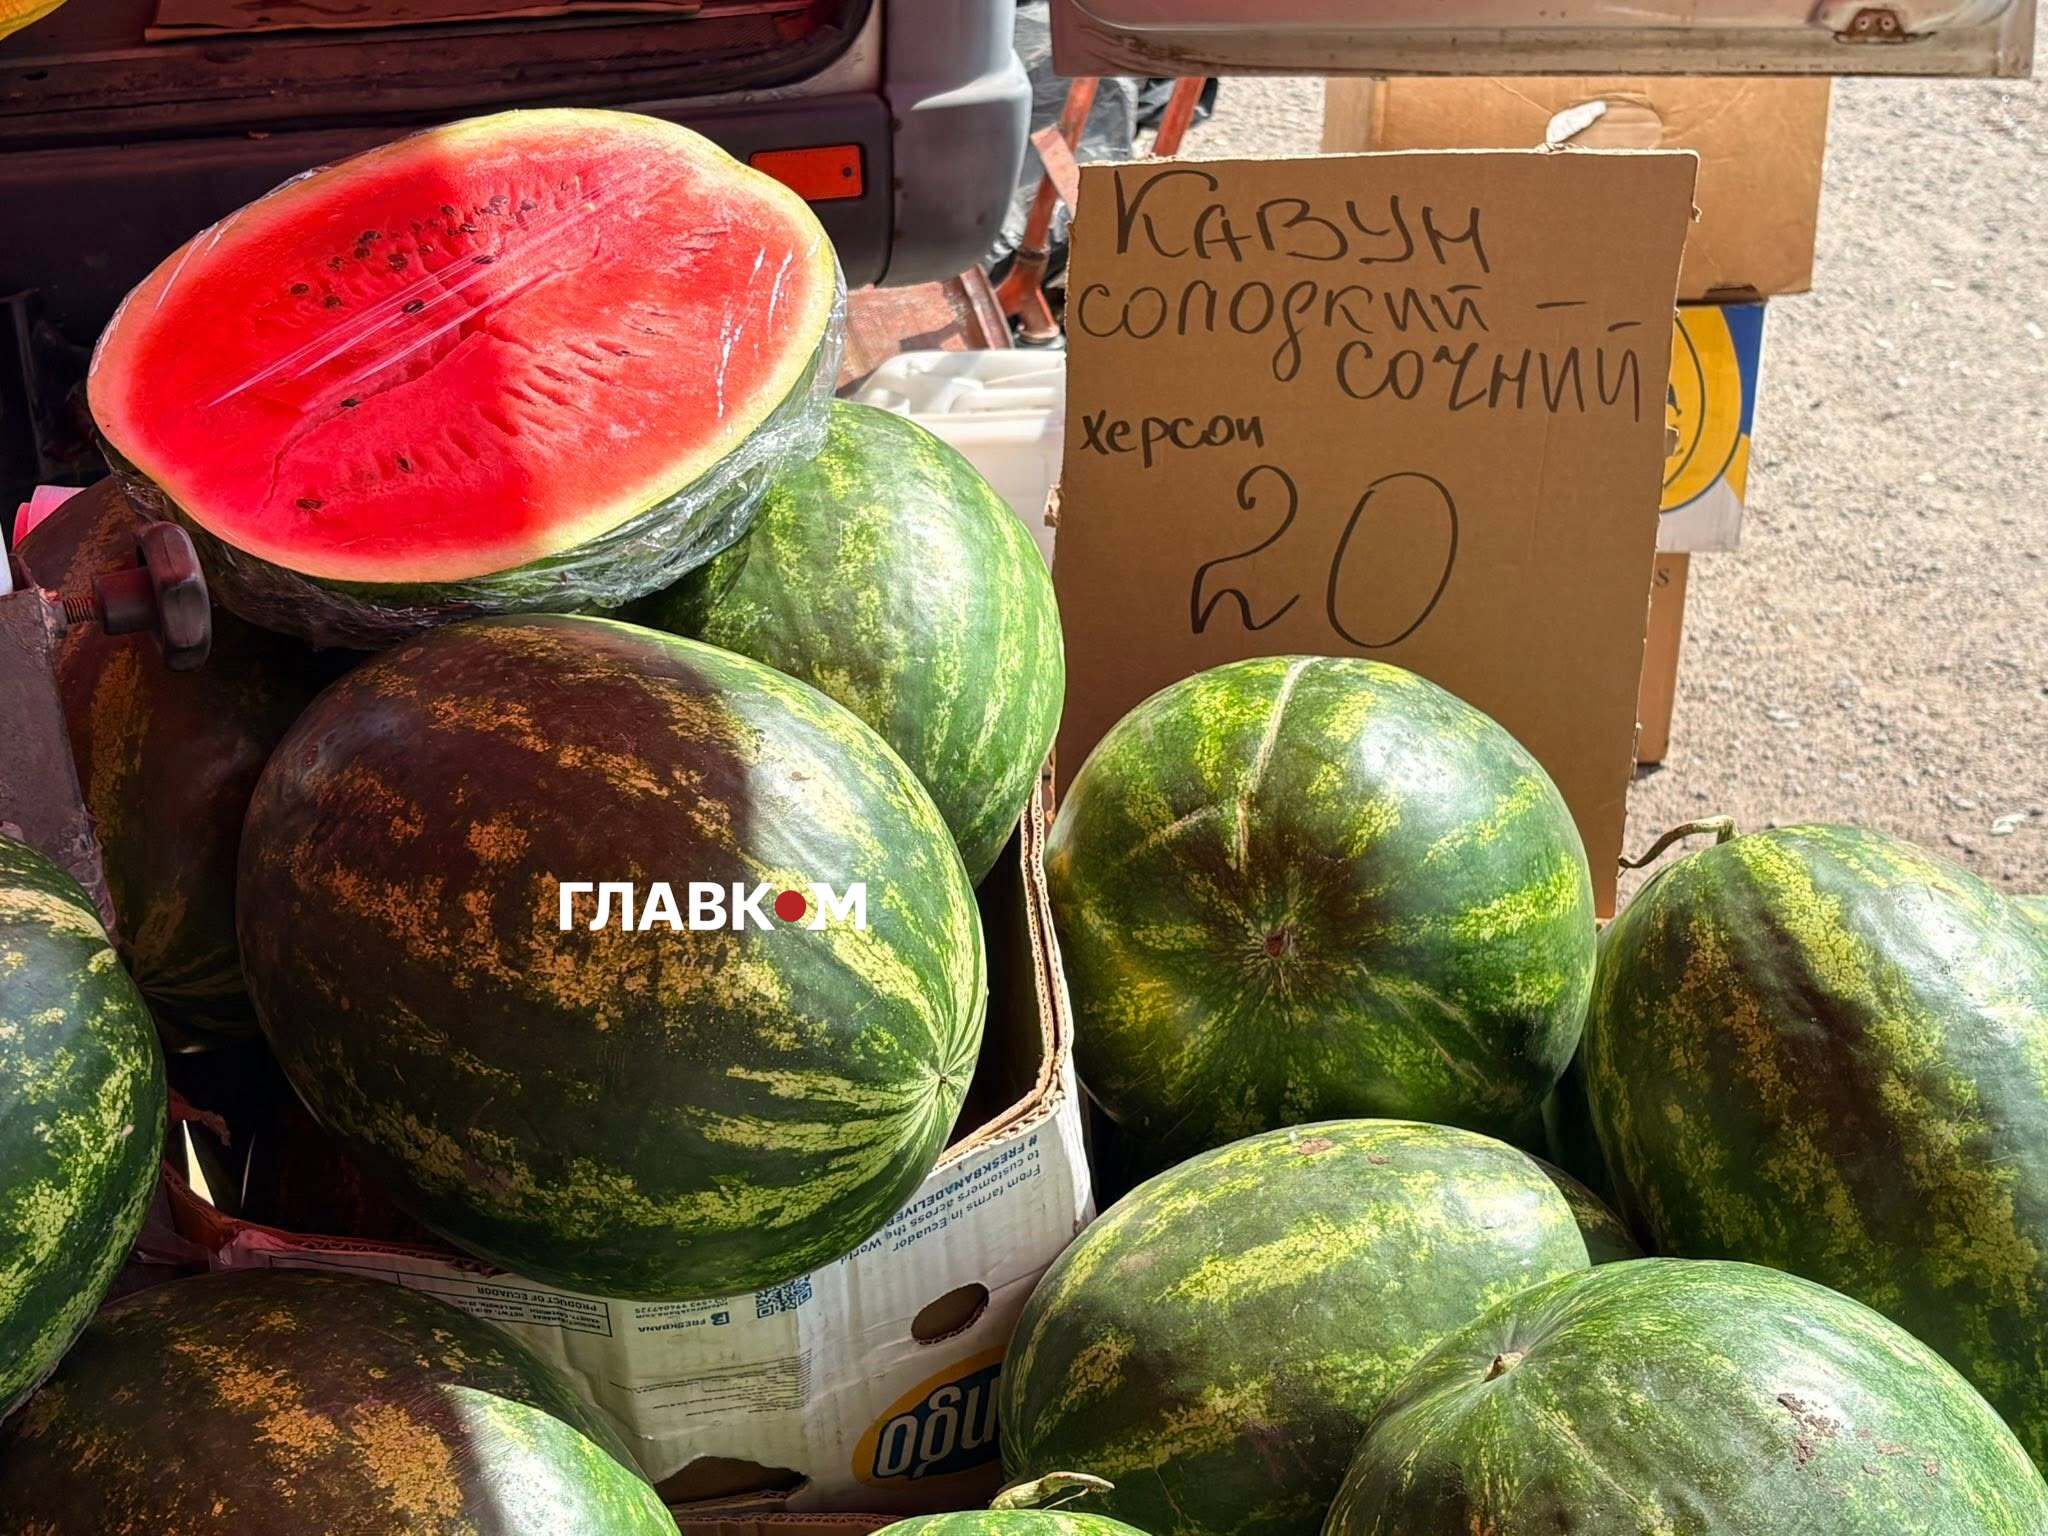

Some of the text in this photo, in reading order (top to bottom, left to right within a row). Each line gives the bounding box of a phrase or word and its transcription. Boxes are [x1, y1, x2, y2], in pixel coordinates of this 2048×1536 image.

[1190, 464, 1459, 648] 20
[1027, 1149, 1040, 1162] to
[957, 1159, 1025, 1202] customers
[892, 1164, 1041, 1252] From farms in Ecuador
[909, 1199, 955, 1227] across
[477, 1286, 597, 1312] PRODUCT OF ECUADOR
